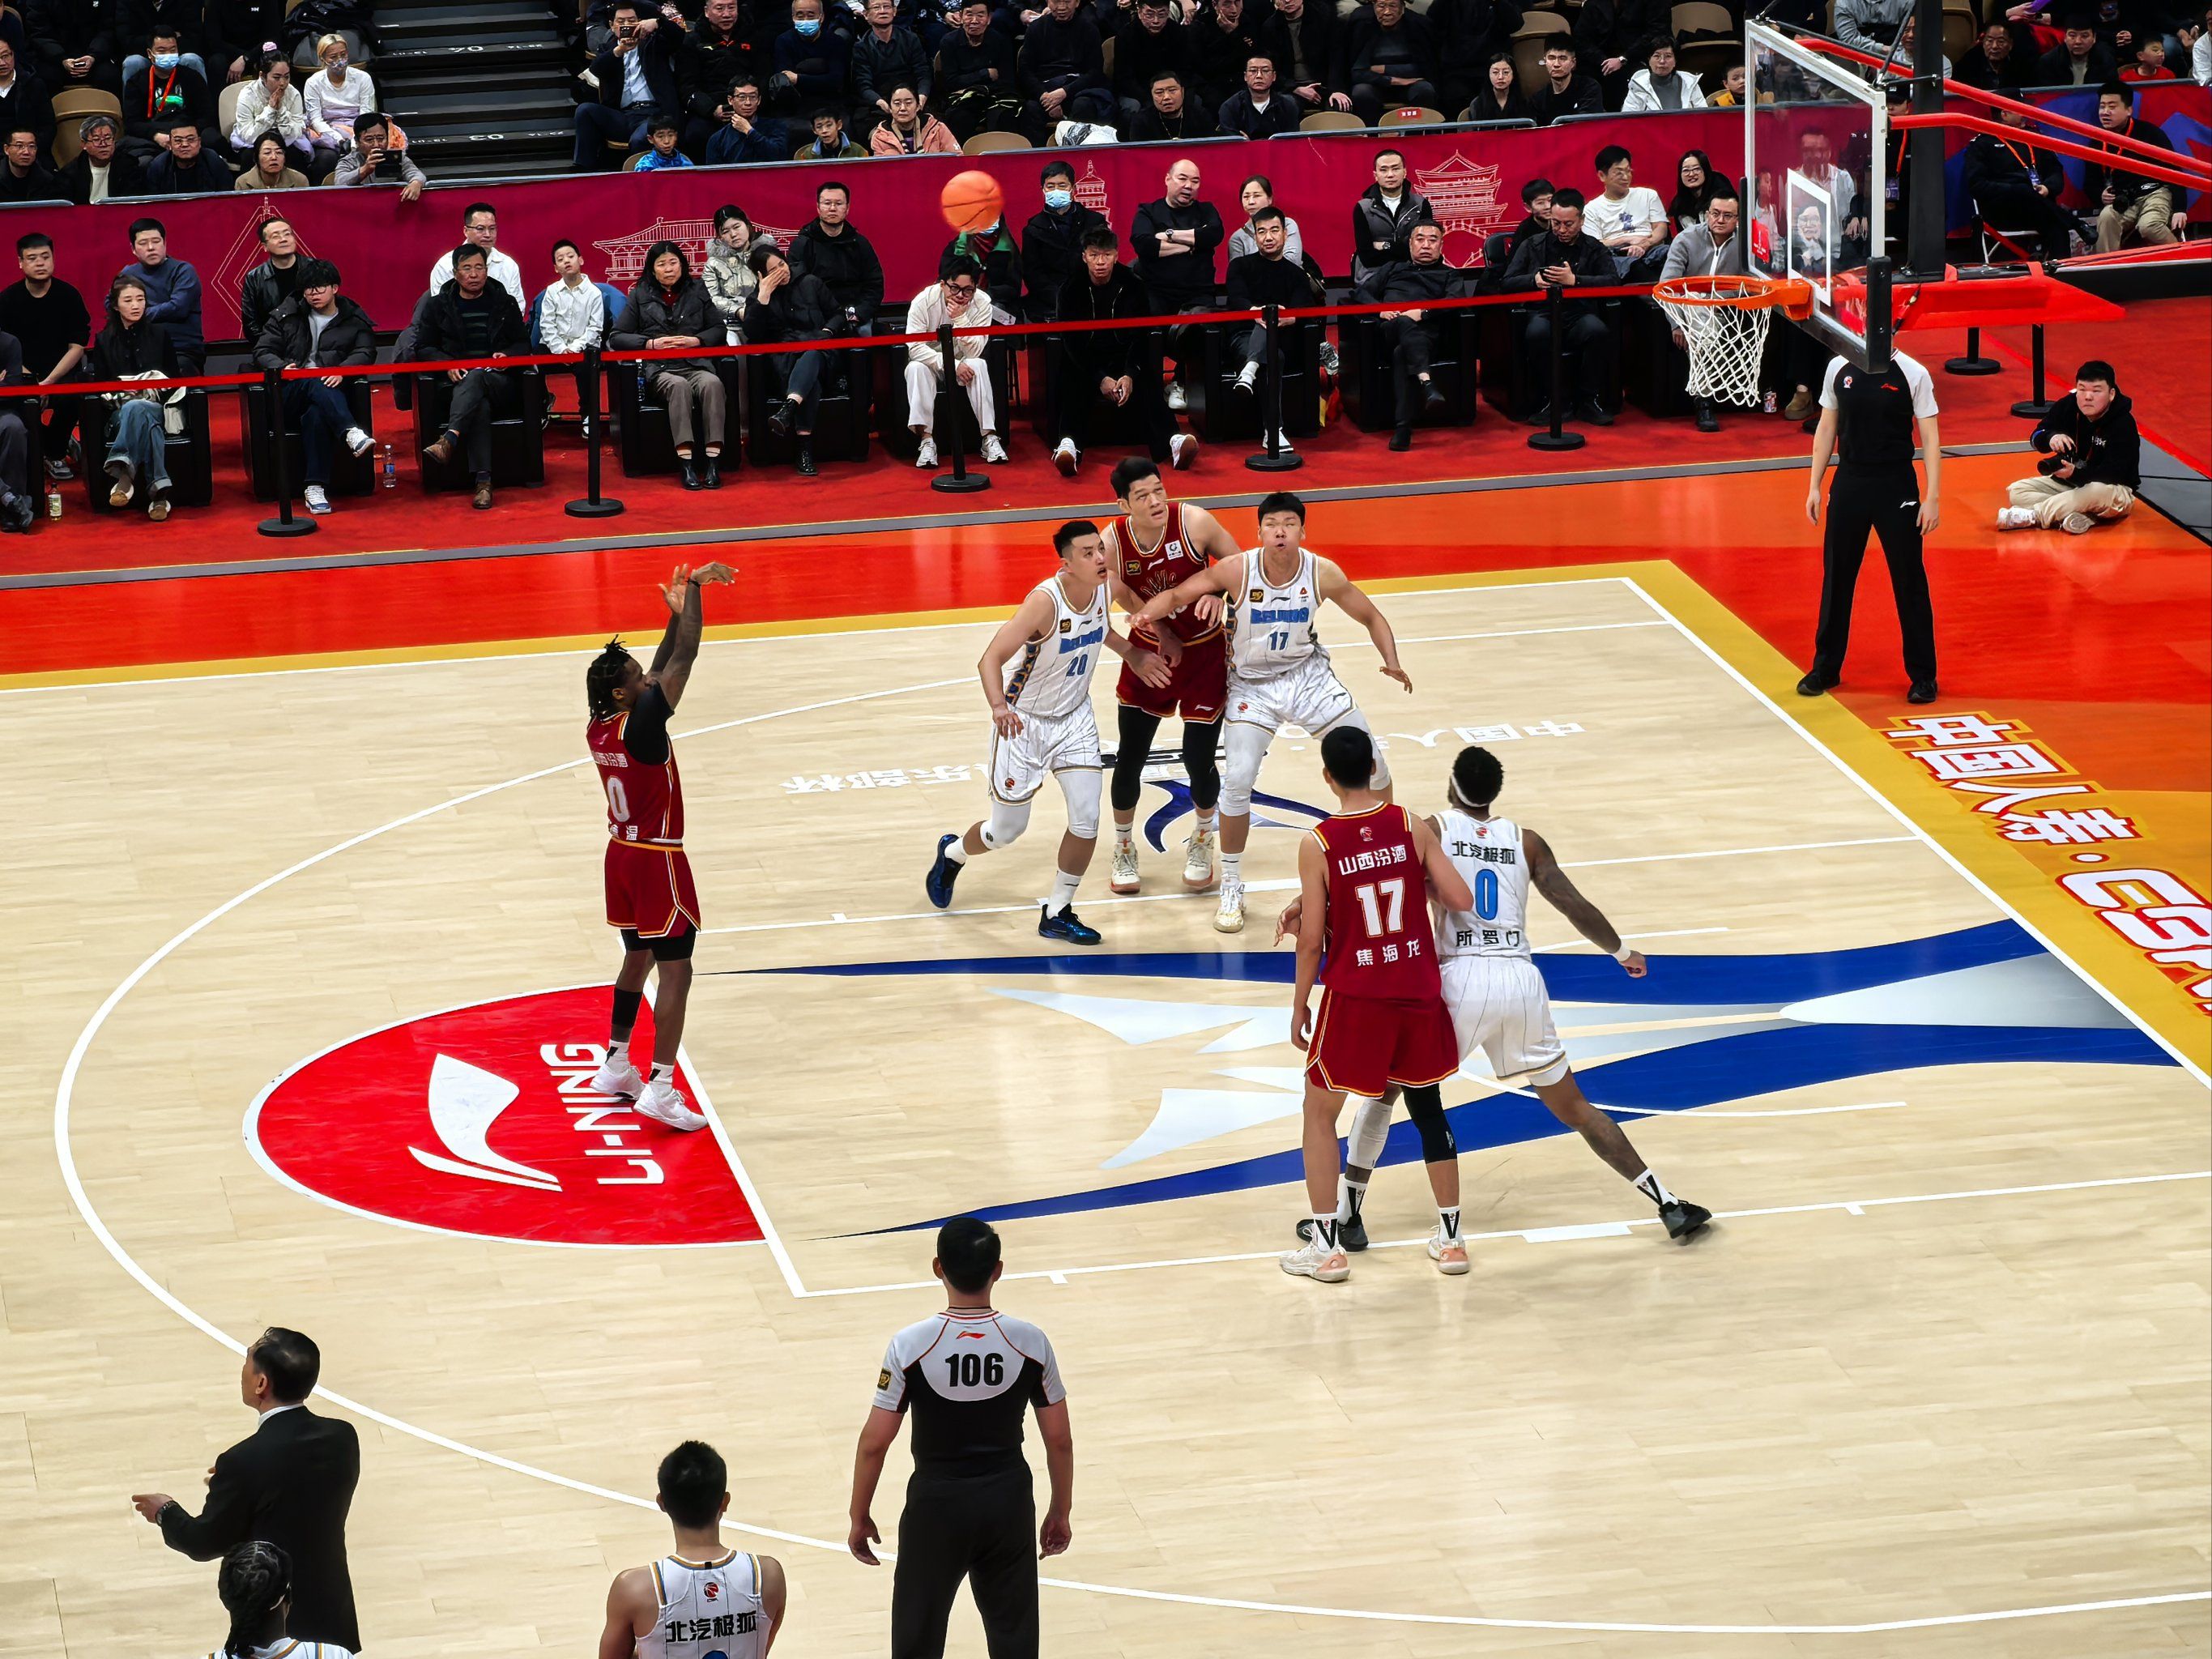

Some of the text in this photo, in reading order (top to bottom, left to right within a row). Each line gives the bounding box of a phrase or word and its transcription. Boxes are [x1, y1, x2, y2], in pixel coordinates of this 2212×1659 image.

[468, 133, 505, 142] 03
[1269, 631, 1289, 651] 17
[1065, 654, 1089, 677] 20
[1375, 720, 1587, 750] 中国人
[778, 763, 990, 795] 乐部杯
[607, 775, 631, 823] 0
[1338, 844, 1408, 876] 山西汾酒
[1451, 840, 1517, 865] 北汽极狐
[1355, 876, 1405, 938] 17
[1474, 868, 1498, 921] 0
[539, 1043, 665, 1184] LI-NING
[944, 1352, 1004, 1388] 106
[664, 1610, 757, 1643] 北汽极狐
